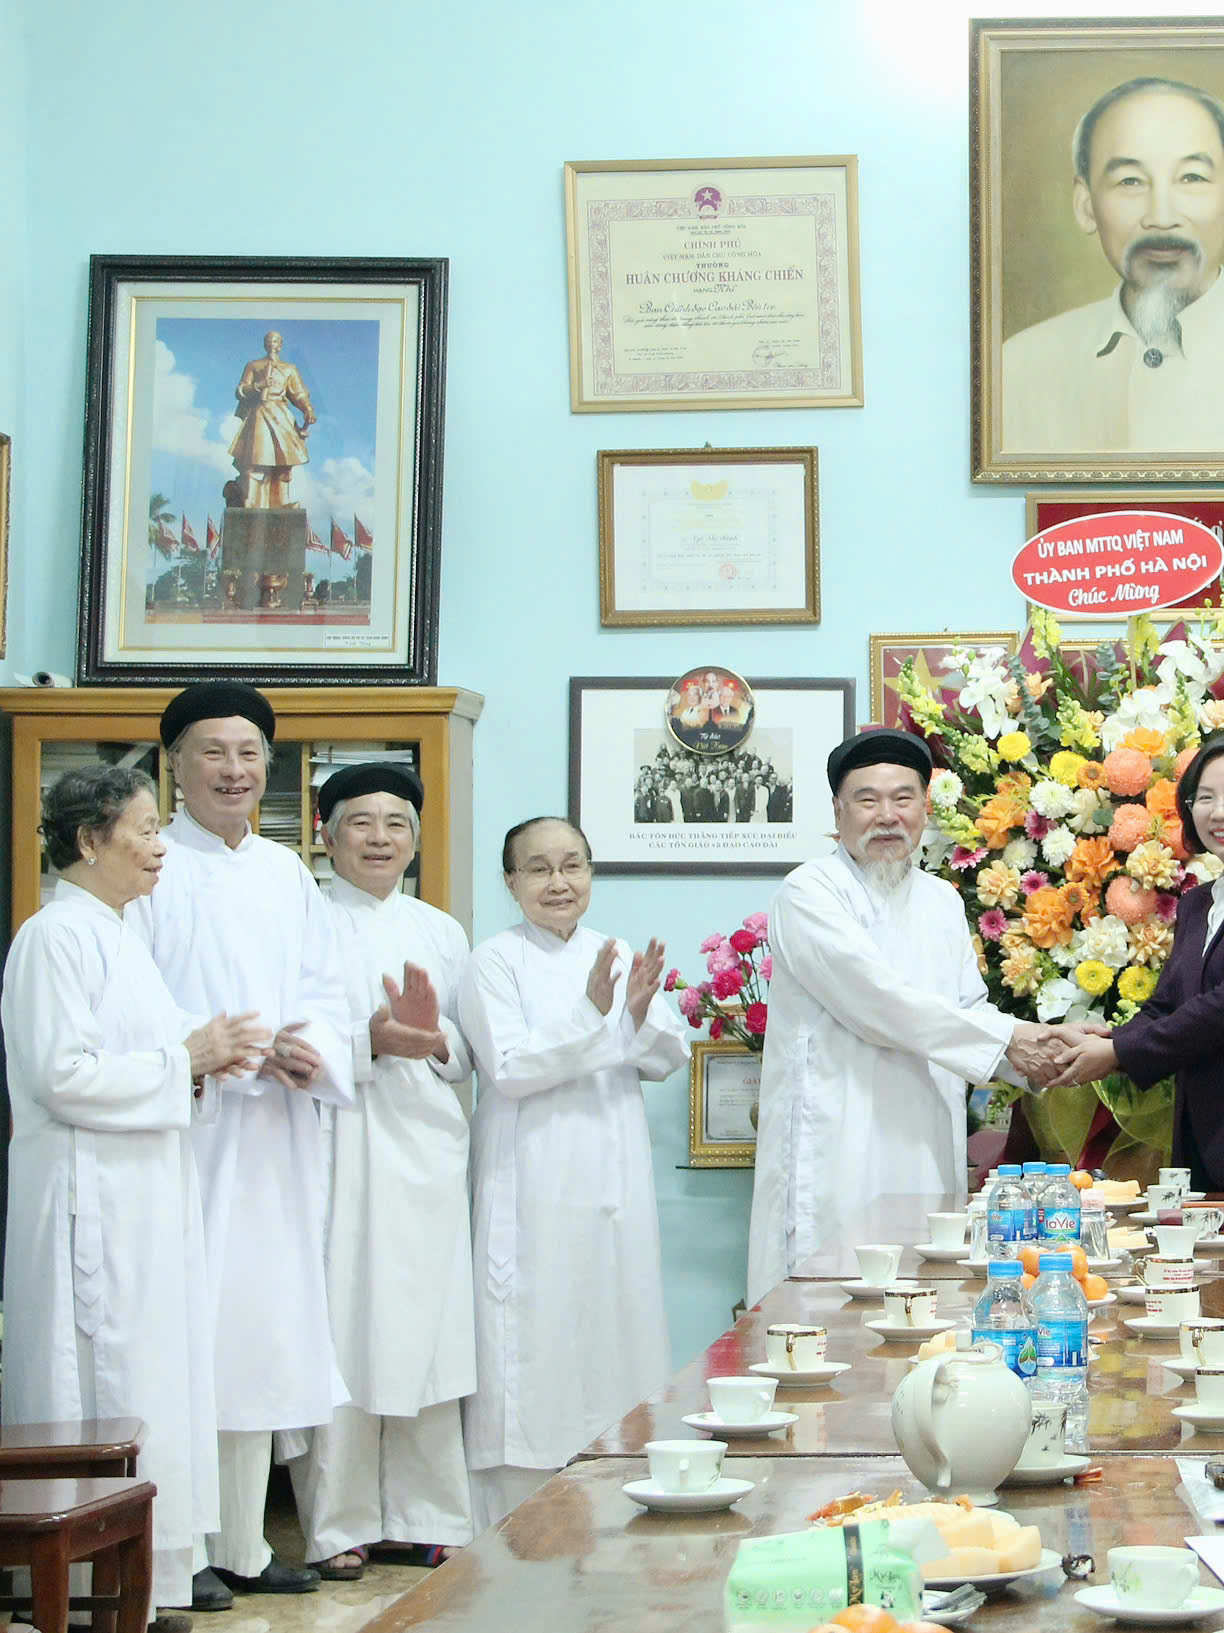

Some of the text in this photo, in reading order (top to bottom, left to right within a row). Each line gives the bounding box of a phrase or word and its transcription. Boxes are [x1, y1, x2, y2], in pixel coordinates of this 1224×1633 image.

[625, 270, 661, 285] HUÂN
[663, 269, 716, 284] CHƯƠNG
[718, 268, 762, 282] KHÁNG
[1037, 528, 1184, 559] ỦY BAN MTTQ VIỆT NAM
[1023, 552, 1208, 586] THÀNH PHỐ HÀ NỘI
[1068, 583, 1161, 607] Chúc Mừng
[1045, 1217, 1076, 1229] laVie
